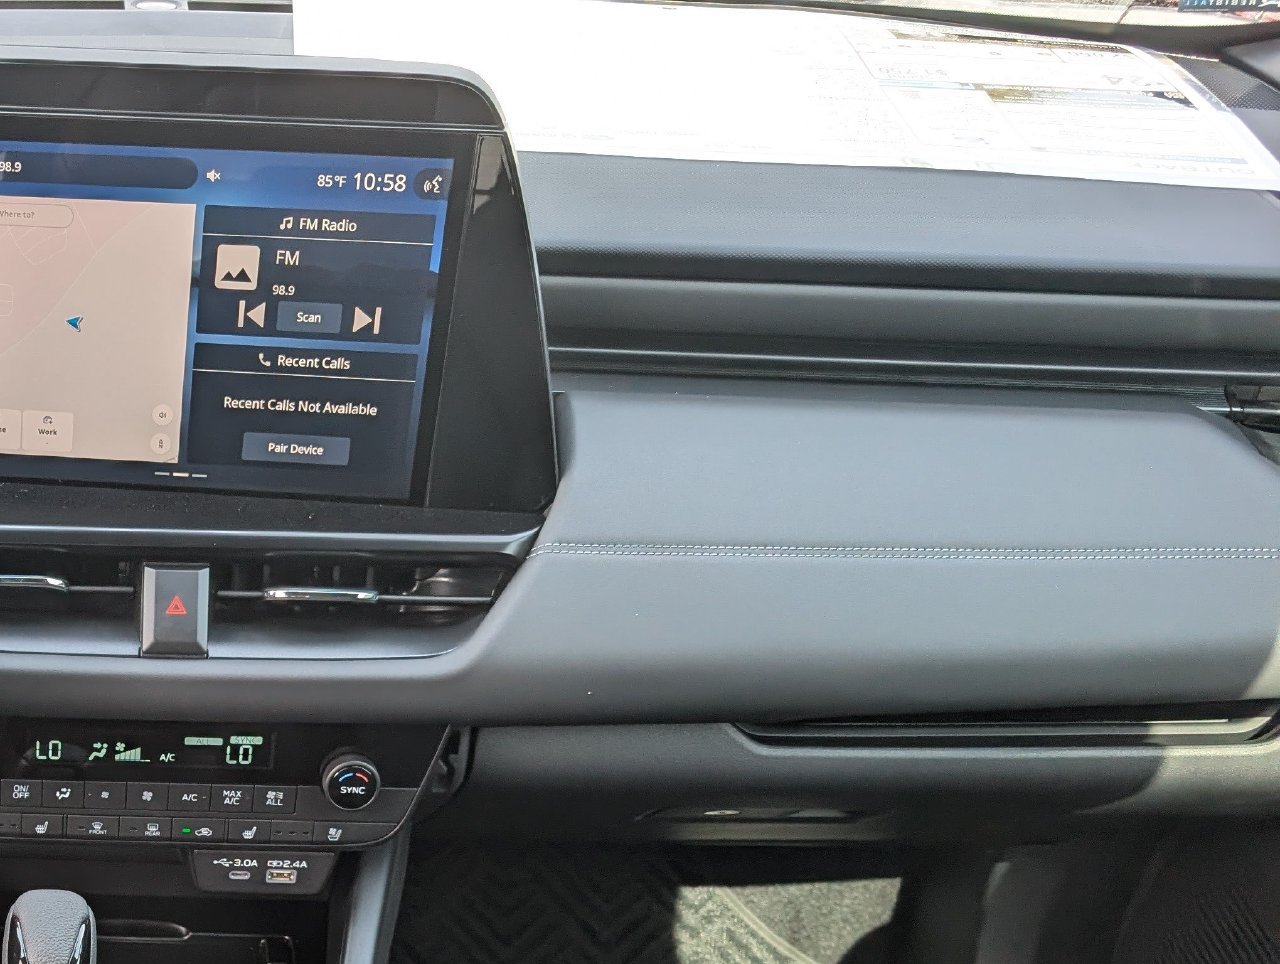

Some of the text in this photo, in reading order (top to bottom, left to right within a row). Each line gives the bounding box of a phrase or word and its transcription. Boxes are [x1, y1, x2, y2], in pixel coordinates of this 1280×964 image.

[353, 172, 407, 192] 10:58
[22, 210, 35, 219] to?
[299, 218, 357, 232] FM Radio
[275, 250, 300, 266] FM
[272, 285, 296, 296] 98.9
[296, 312, 321, 323] Scan
[277, 354, 351, 370] Recent Calls
[223, 396, 378, 416] Recent Calls Not Available
[37, 428, 58, 436] Work
[268, 442, 324, 456] Pair Device
[35, 740, 62, 760] LO
[159, 753, 176, 762] A/C
[225, 745, 253, 765] LO
[13, 784, 29, 792] ON/
[340, 786, 366, 795] SYNC
[12, 791, 30, 799] OFF
[181, 793, 198, 802] A/C
[222, 790, 242, 798] MAX
[224, 797, 240, 806] A/C
[266, 798, 283, 806] ALL
[233, 859, 258, 868] 3.0A
[282, 860, 308, 869] 2.4A
